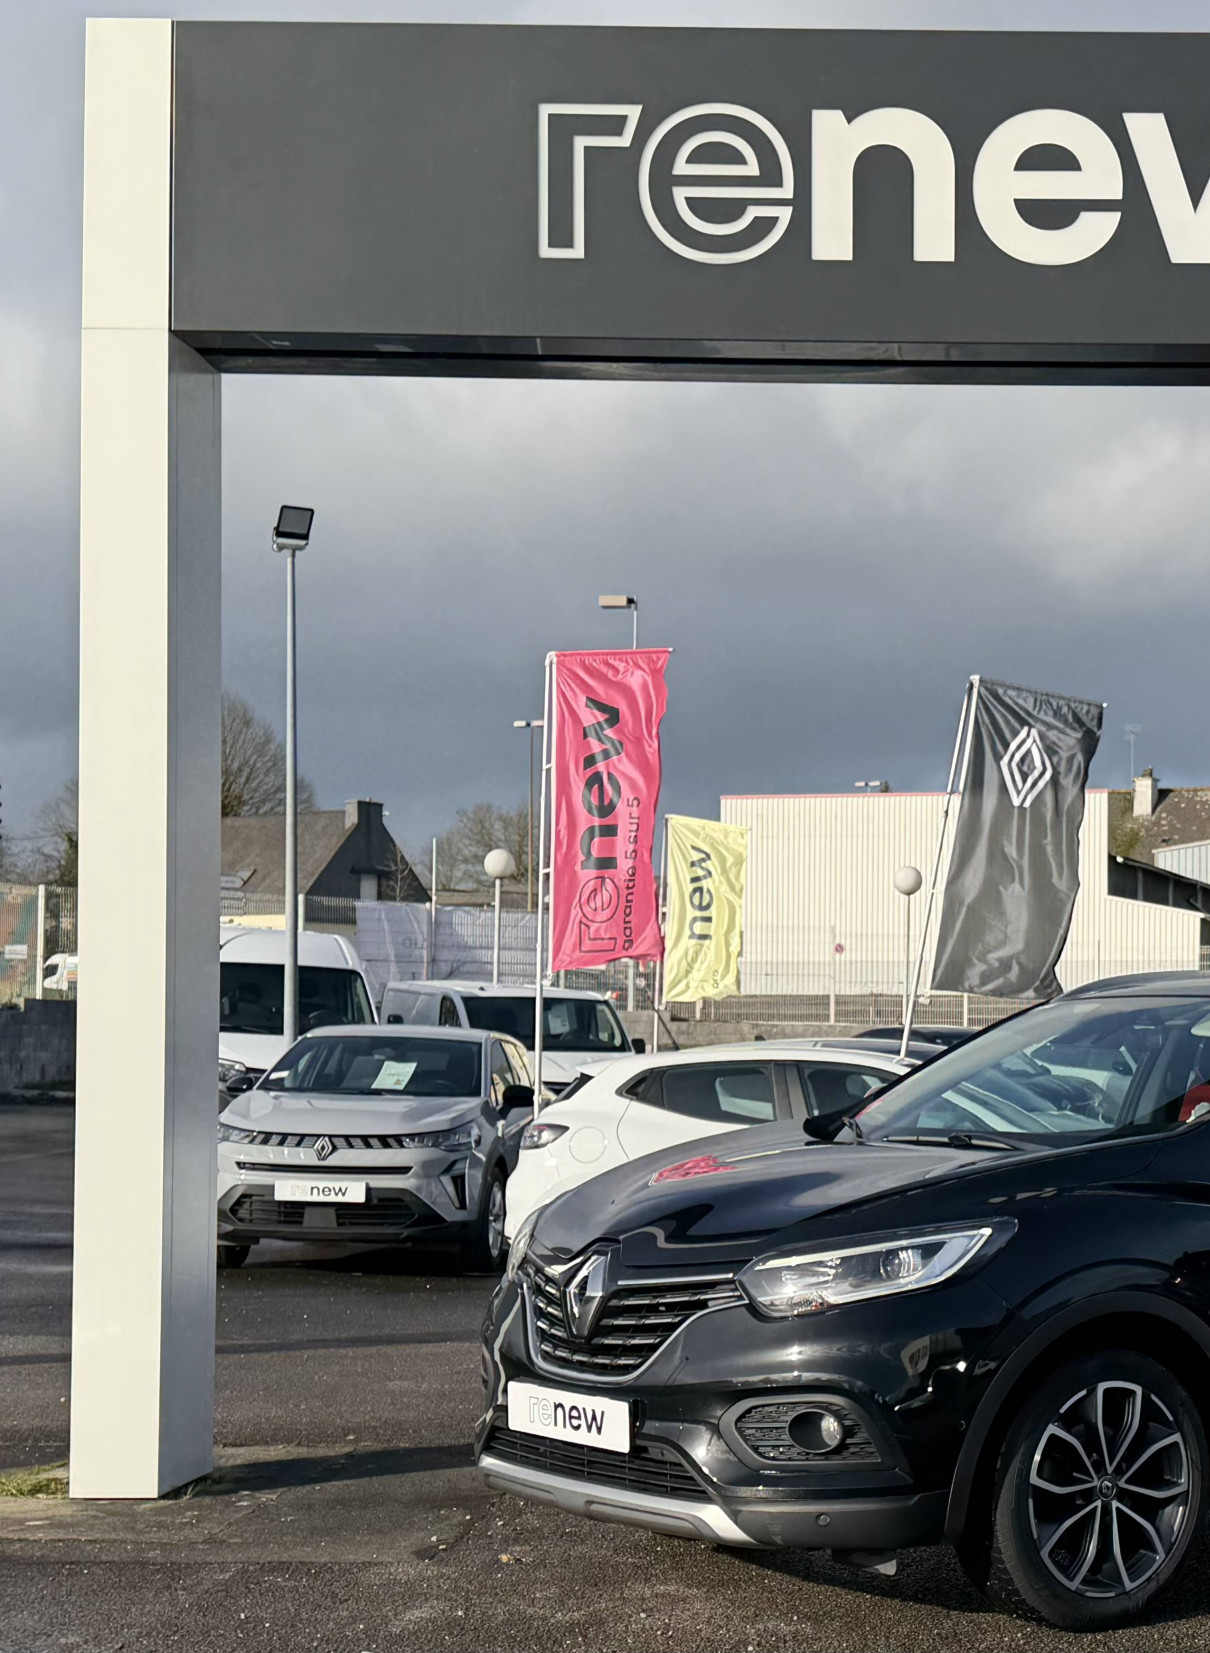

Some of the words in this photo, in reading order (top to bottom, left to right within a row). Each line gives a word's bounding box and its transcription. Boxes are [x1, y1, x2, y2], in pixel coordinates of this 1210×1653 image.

[627, 796, 641, 808] 5
[578, 695, 624, 953] renew
[628, 812, 640, 846] sur
[625, 849, 638, 861] 5
[622, 866, 637, 951] garantie
[528, 1395, 606, 1436] renew
